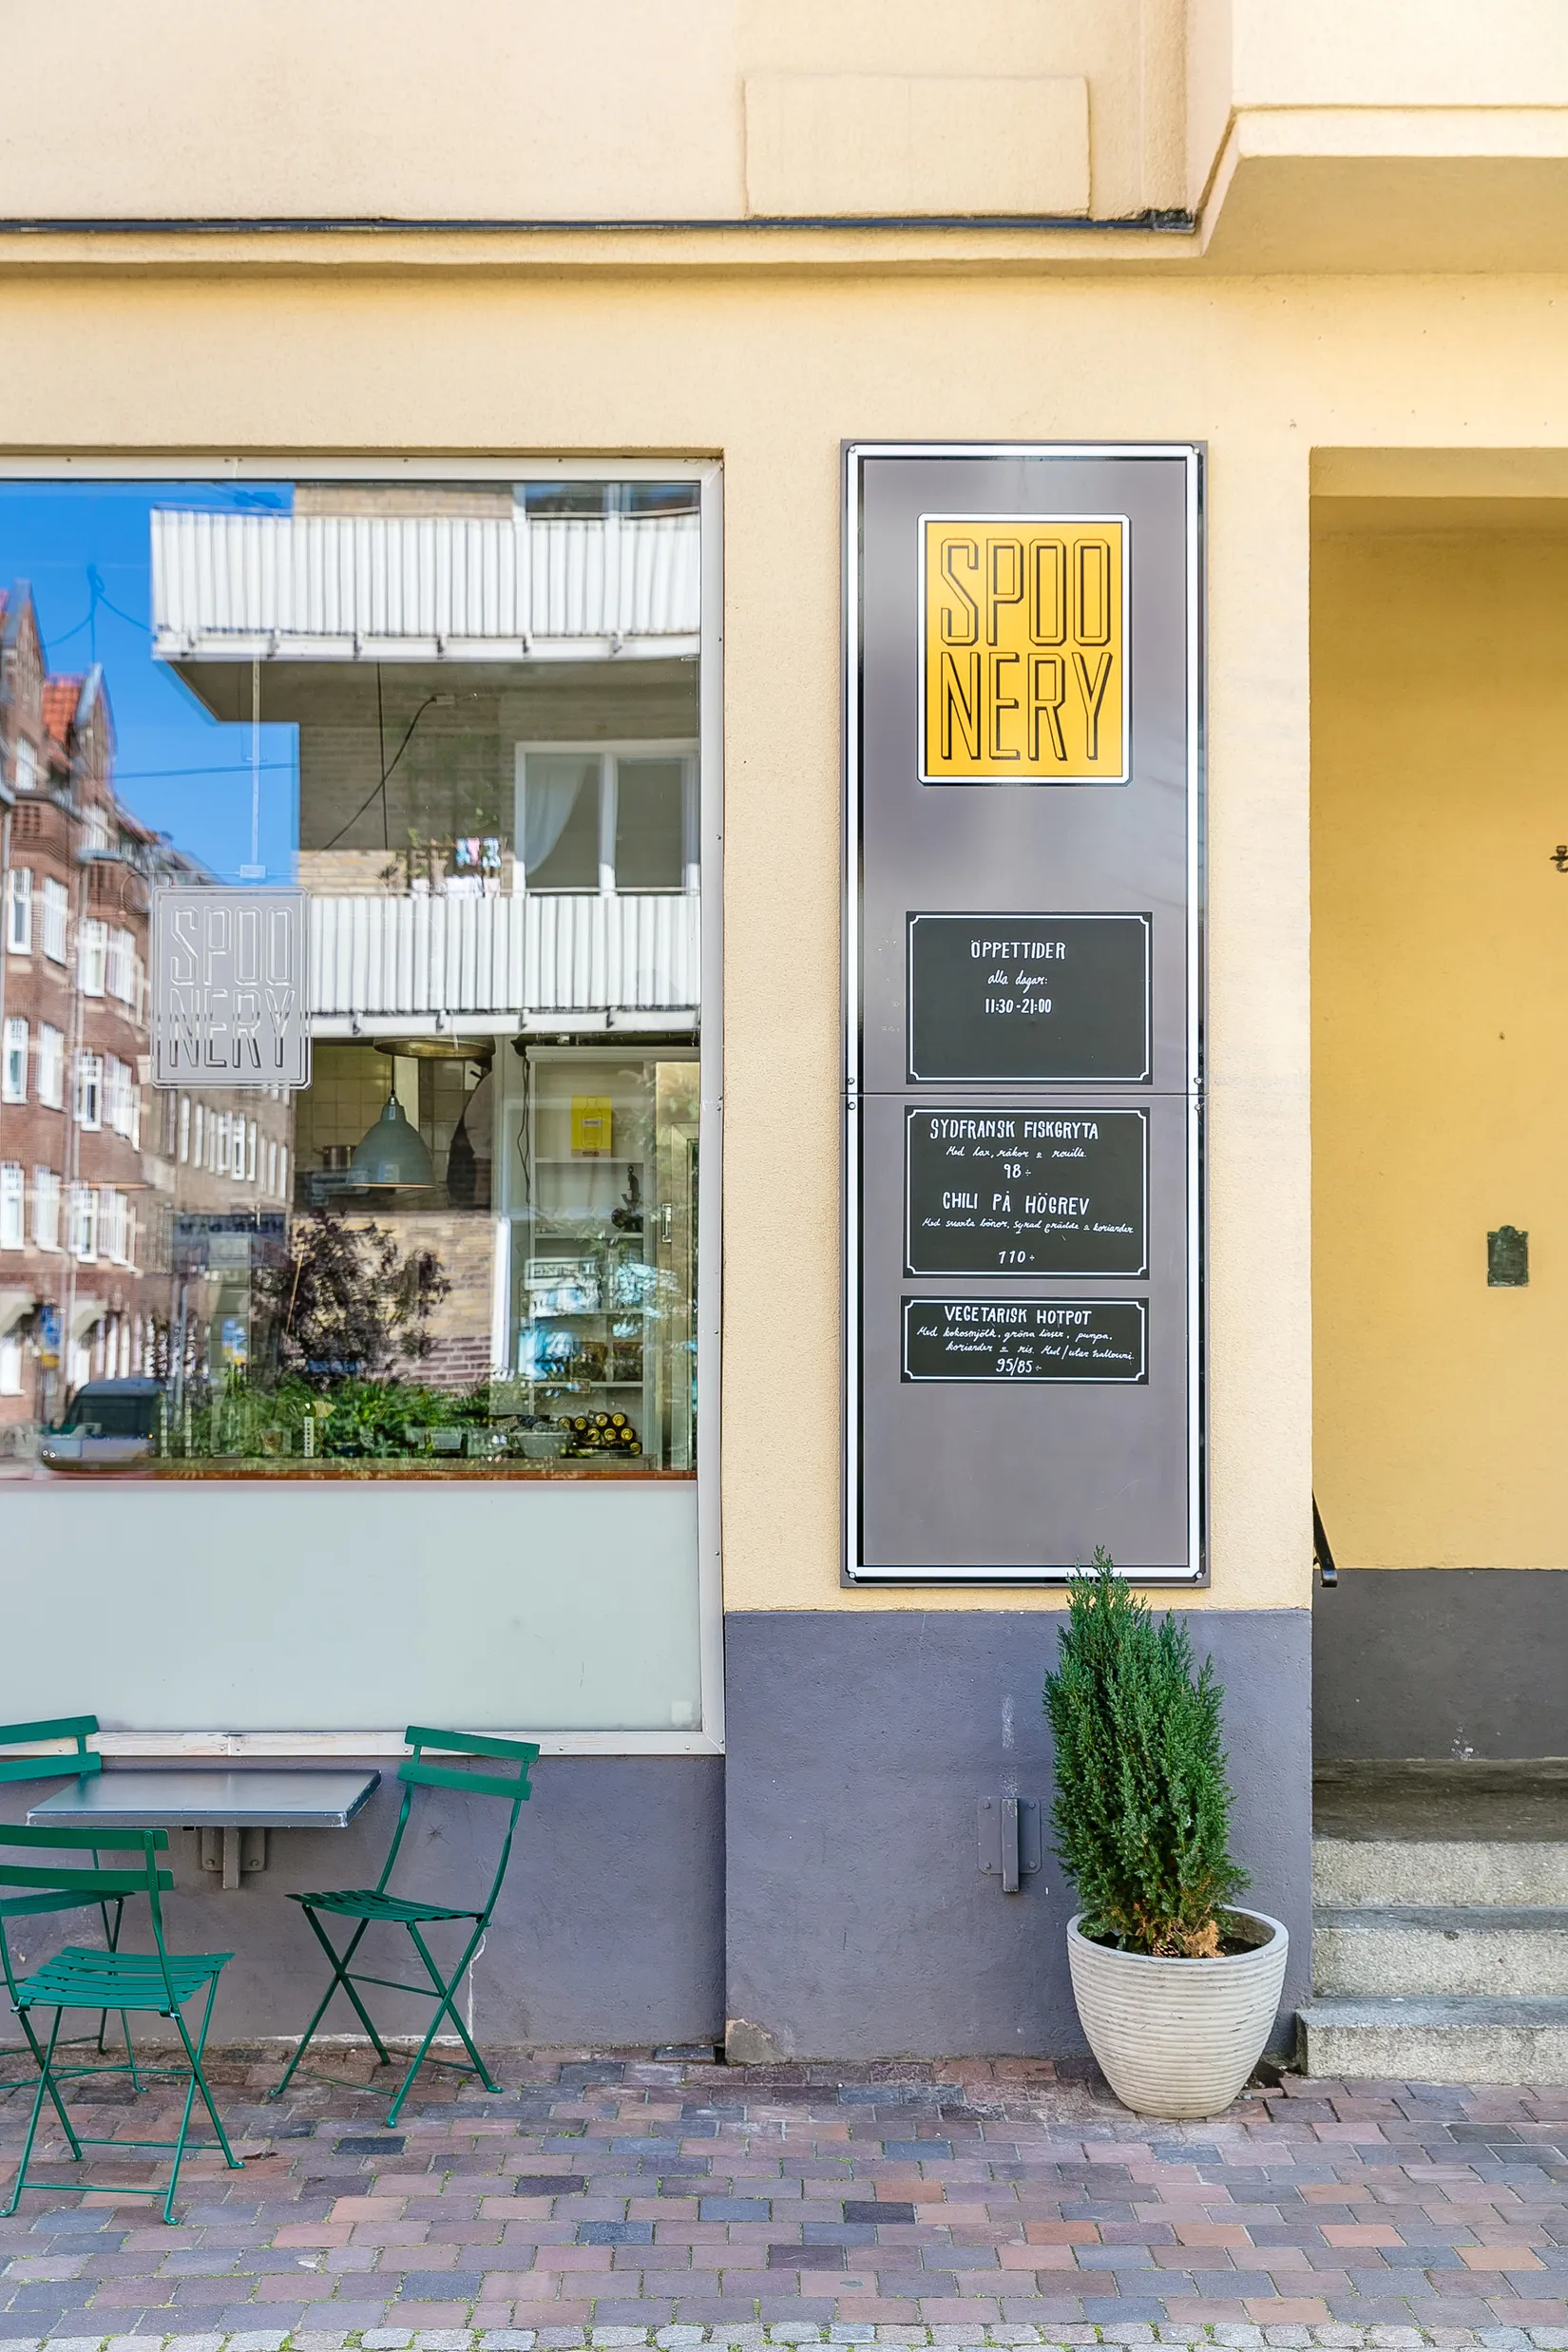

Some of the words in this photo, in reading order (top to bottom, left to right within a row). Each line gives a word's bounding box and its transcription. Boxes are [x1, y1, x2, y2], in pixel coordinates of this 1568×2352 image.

[941, 539, 1111, 647] SPOO
[941, 652, 1113, 761] NERY
[170, 906, 295, 986] SPOO
[970, 939, 1066, 960] ÖPPETTIDER
[987, 969, 1009, 985] alla
[1015, 969, 1048, 994] dagar:
[169, 988, 296, 1068] NERY
[929, 1118, 1016, 1140] SYDFRANSK
[1023, 1120, 1099, 1140] FISKGRYTA
[946, 1145, 966, 1157] Med
[996, 1146, 1029, 1158] räkor
[1051, 1146, 1087, 1158] rouille.
[942, 1191, 979, 1210] CHILI
[992, 1190, 1011, 1213] PÅ
[1024, 1192, 1090, 1215] HÖGREV
[921, 1217, 941, 1227] Med
[945, 1217, 976, 1228] svarta
[1043, 1221, 1080, 1233] grädde
[1092, 1222, 1135, 1233] koriander
[944, 1305, 1027, 1324] VEGETARISK
[1036, 1309, 1093, 1326] HOTPOT
[916, 1326, 939, 1337] Med
[1002, 1329, 1036, 1344] gröna
[945, 1341, 993, 1352] koriander
